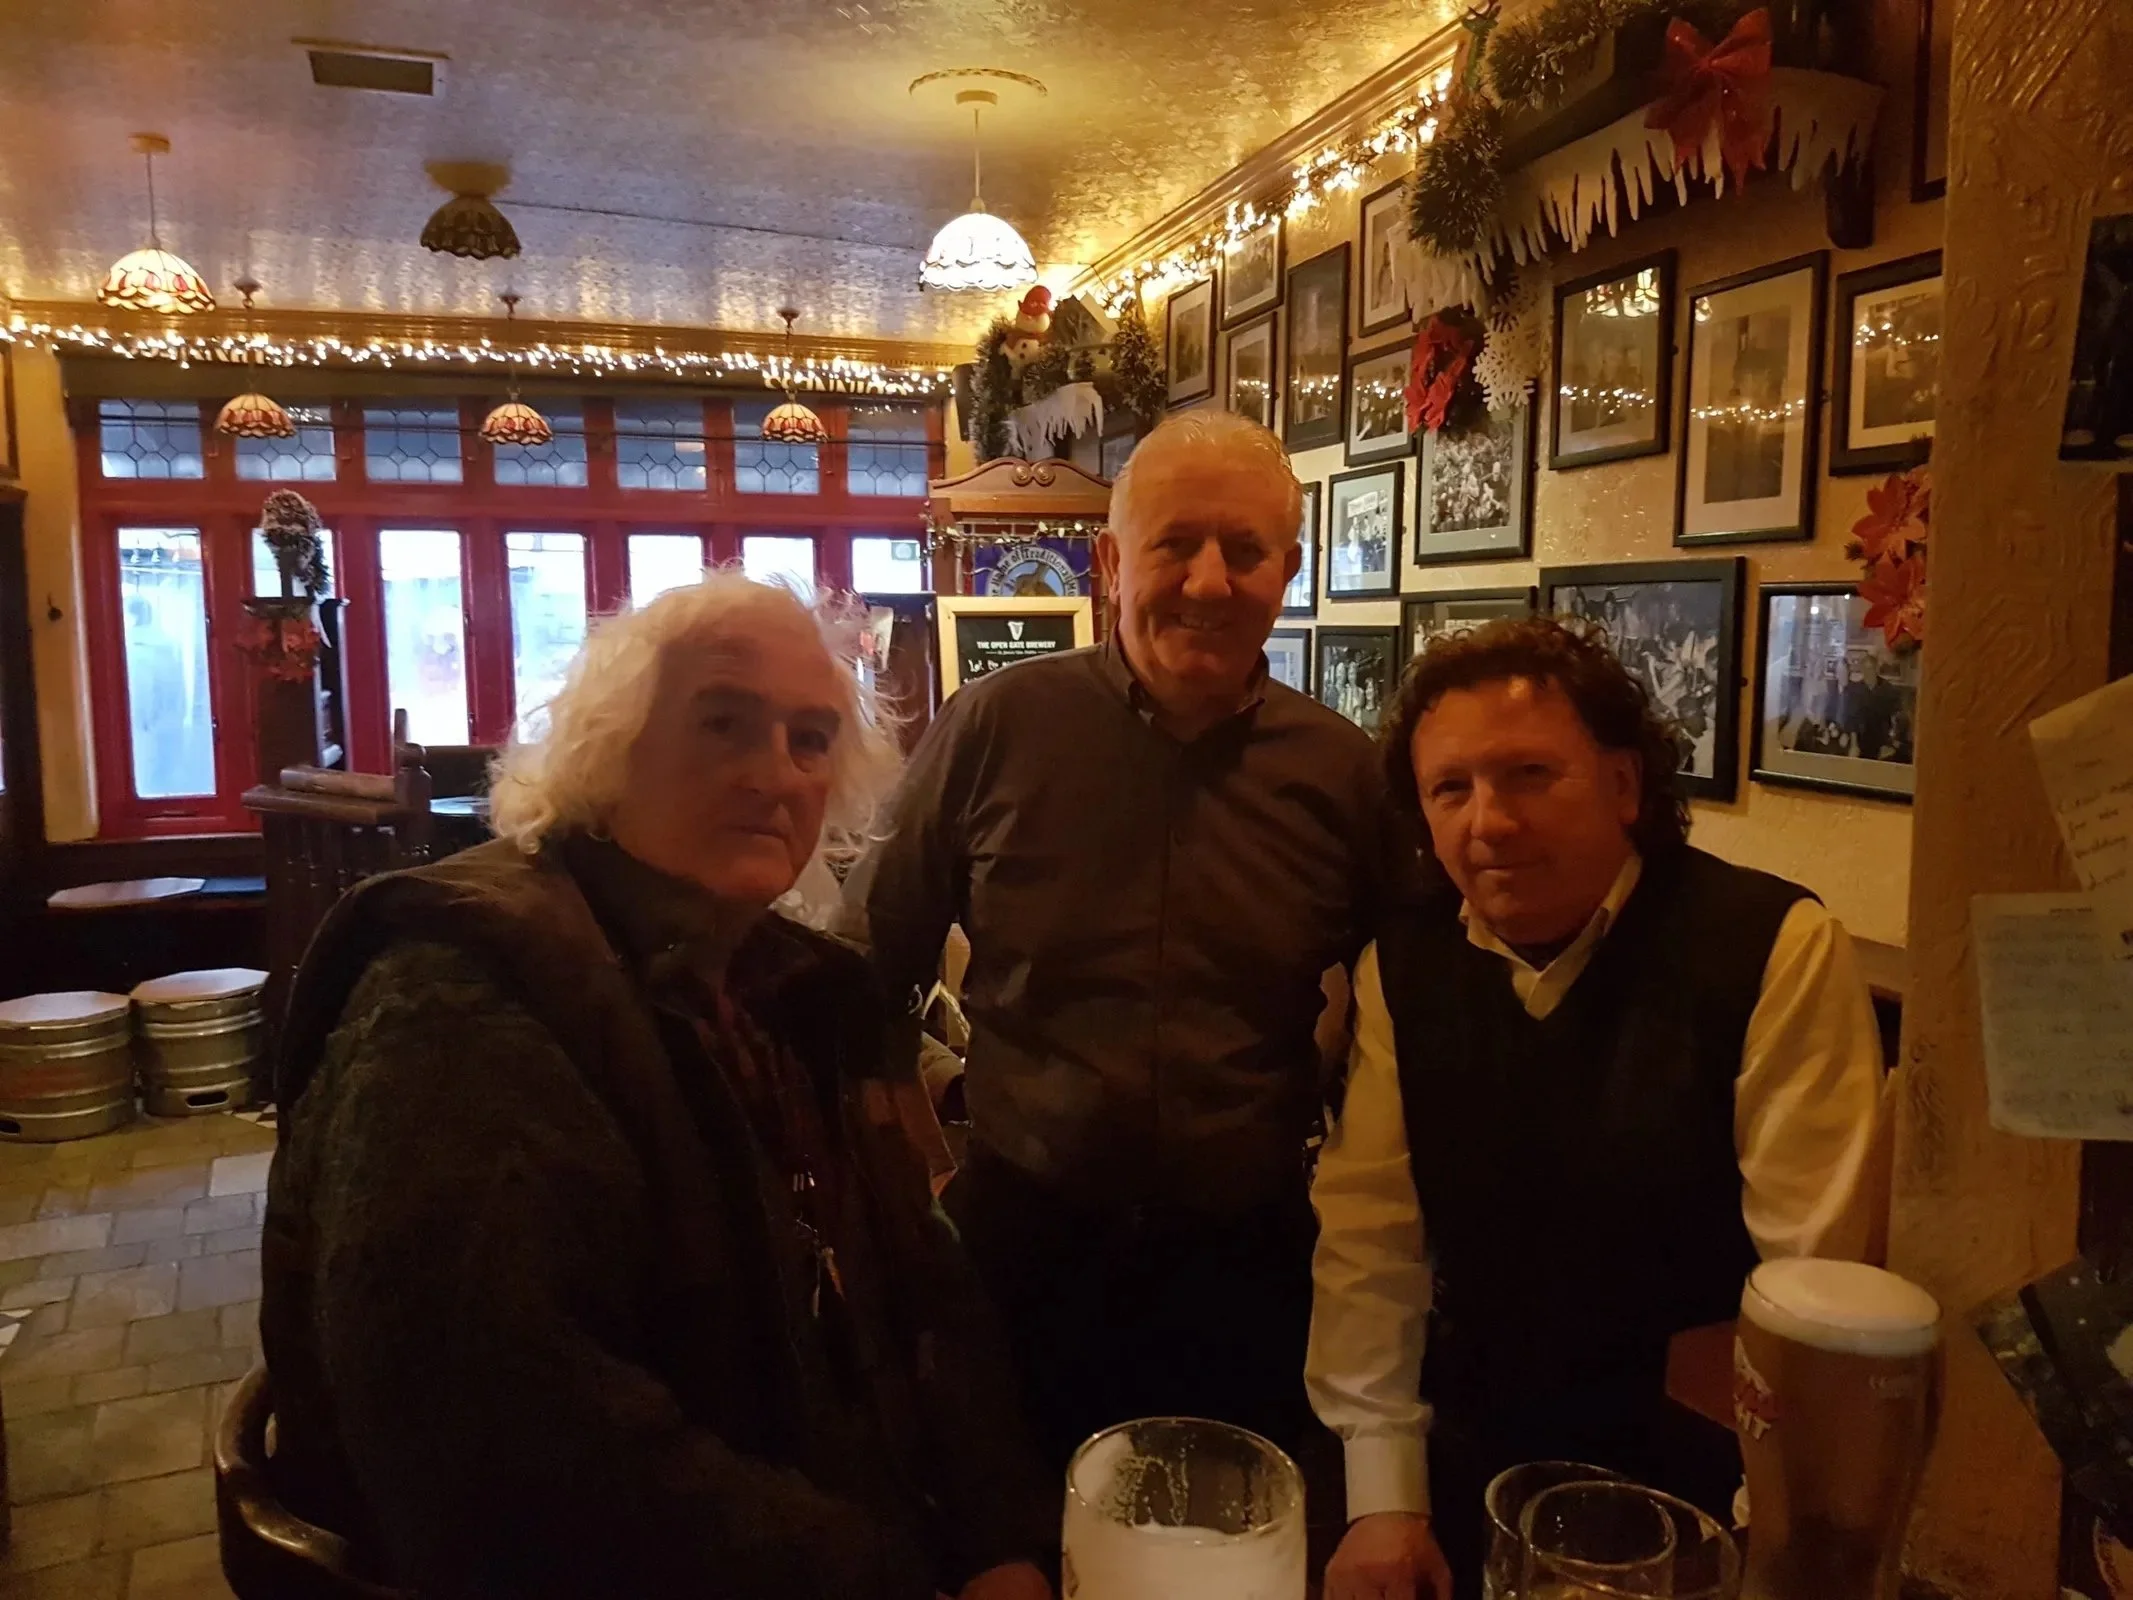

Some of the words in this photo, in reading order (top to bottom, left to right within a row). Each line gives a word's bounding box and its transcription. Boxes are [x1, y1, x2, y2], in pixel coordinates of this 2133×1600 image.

[976, 641, 989, 649] THE
[990, 641, 1008, 649] OPEN
[1009, 641, 1024, 649] GATE
[1025, 641, 1055, 649] BREWERY
